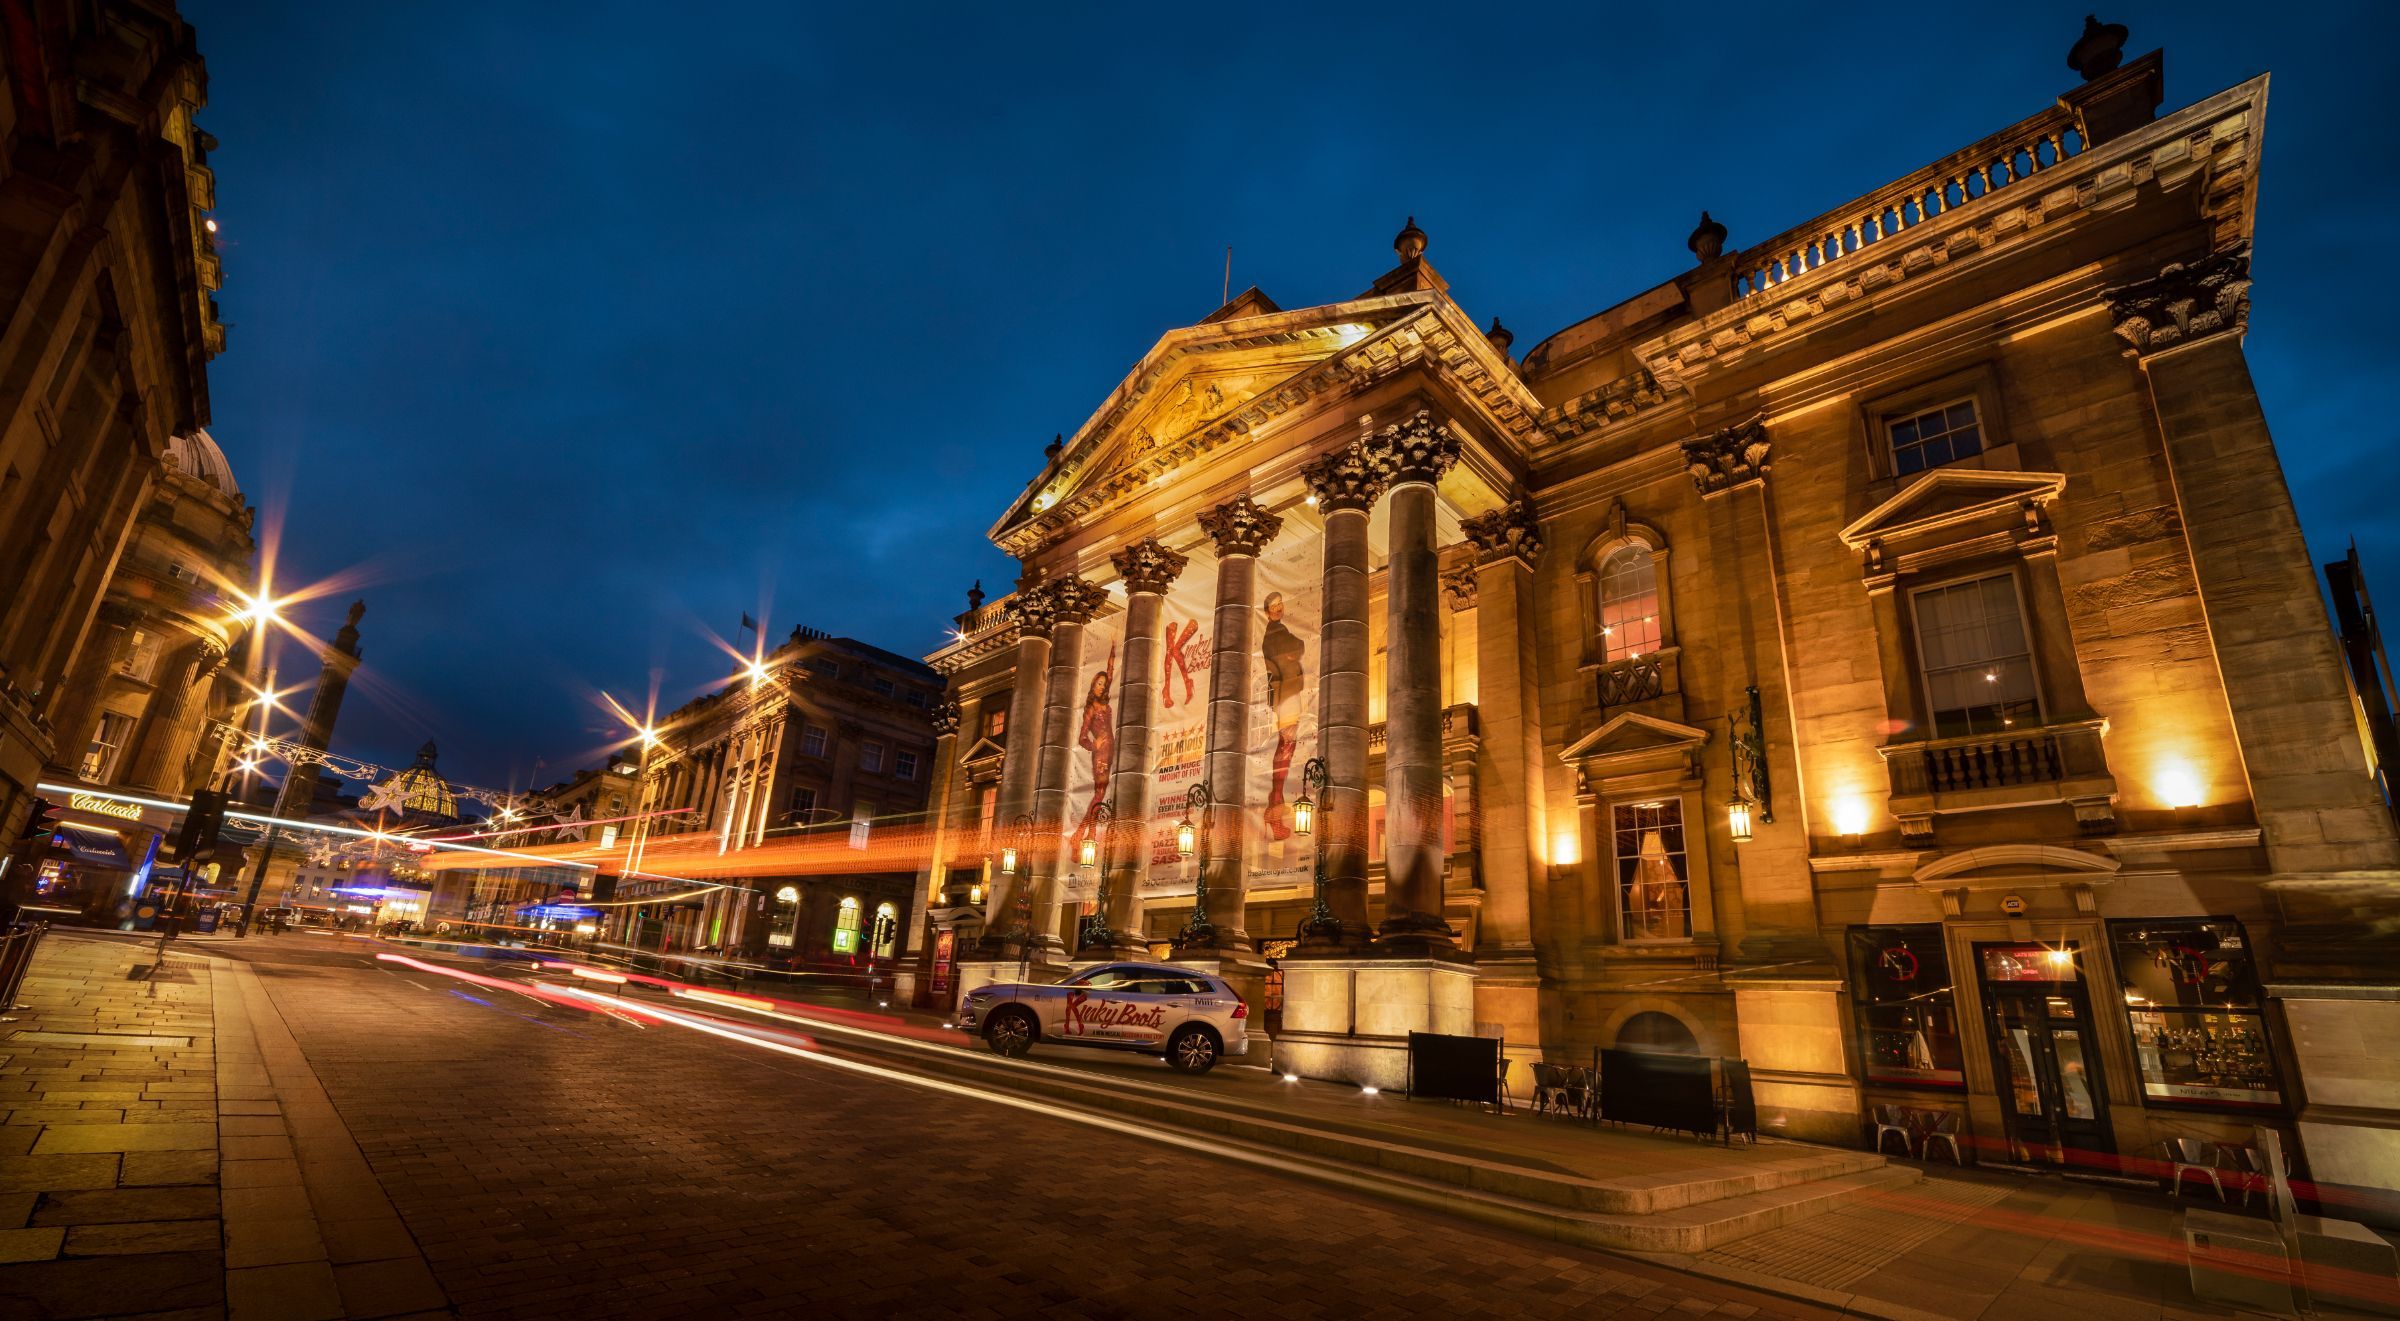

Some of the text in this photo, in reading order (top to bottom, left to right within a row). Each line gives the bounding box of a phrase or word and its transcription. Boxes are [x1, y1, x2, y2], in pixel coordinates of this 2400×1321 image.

[1158, 765, 1174, 774] AND
[1181, 760, 1201, 770] HUGE
[71, 793, 143, 821] Carluccio's
[1064, 992, 1166, 1035] Kinky Boots
